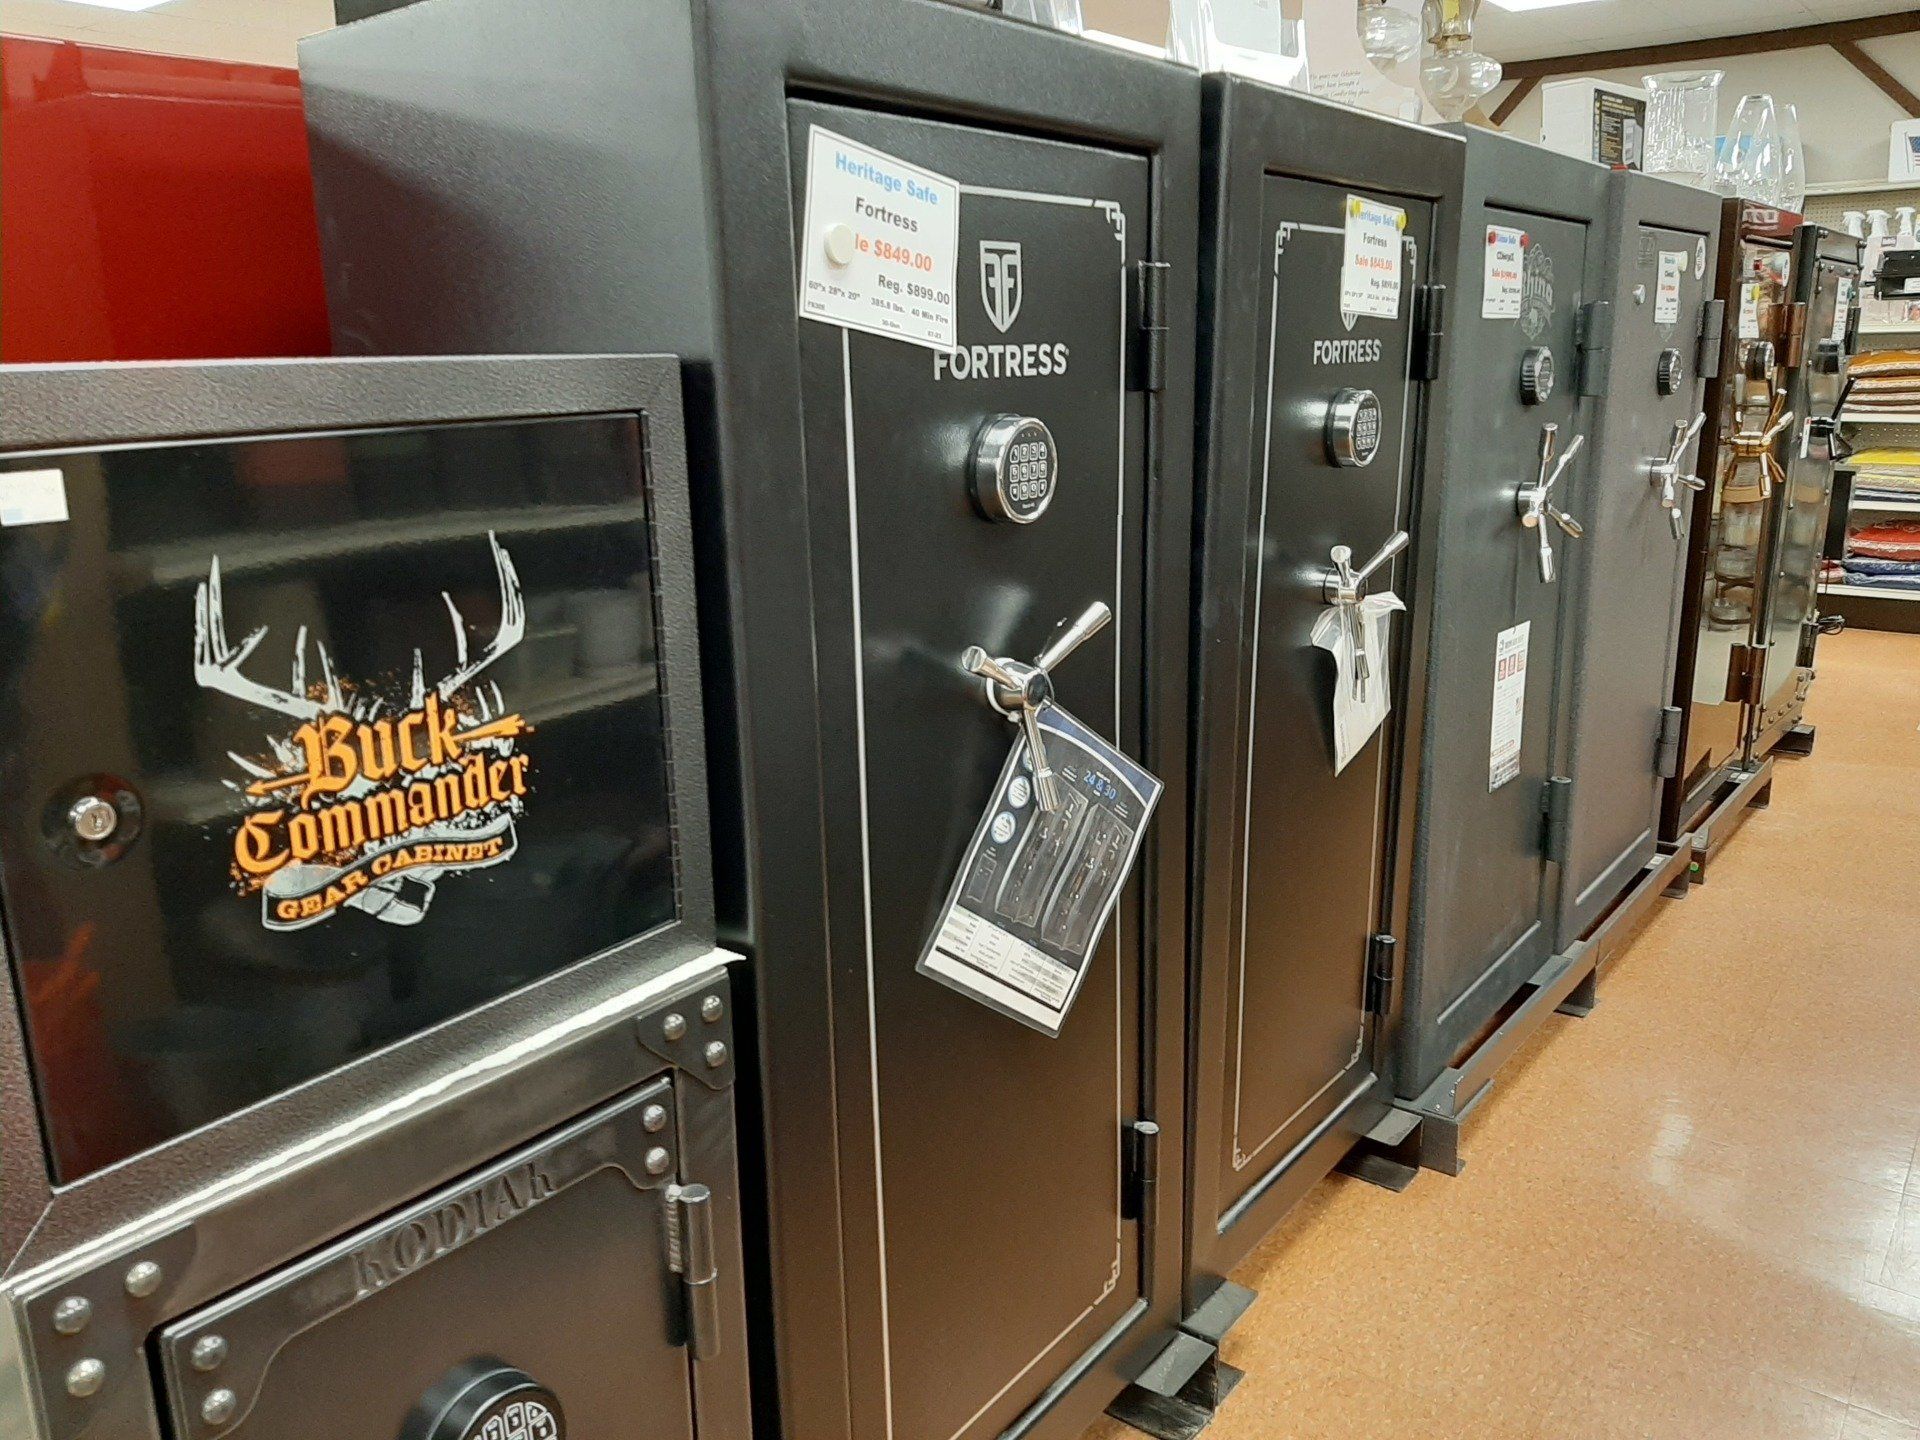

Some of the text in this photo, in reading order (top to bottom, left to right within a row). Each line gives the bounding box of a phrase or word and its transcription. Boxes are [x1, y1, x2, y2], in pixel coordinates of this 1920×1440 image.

[835, 151, 938, 205] Heritage Safe
[855, 196, 918, 232] Fortress
[874, 239, 932, 271] $849.00
[1363, 232, 1388, 247] Fortress
[1354, 253, 1369, 268] Sale
[878, 275, 950, 305] Reg. $899.00
[935, 313, 949, 324] Fire
[933, 343, 1067, 381] FORTRESS
[1313, 339, 1381, 365] FORTRESS
[293, 692, 464, 810] Buck
[1083, 770, 1097, 785] 24
[1103, 785, 1117, 800] 30
[234, 753, 529, 873] Commander
[276, 837, 503, 920] GEAR CABINET
[351, 1161, 558, 1296] KODIAK
